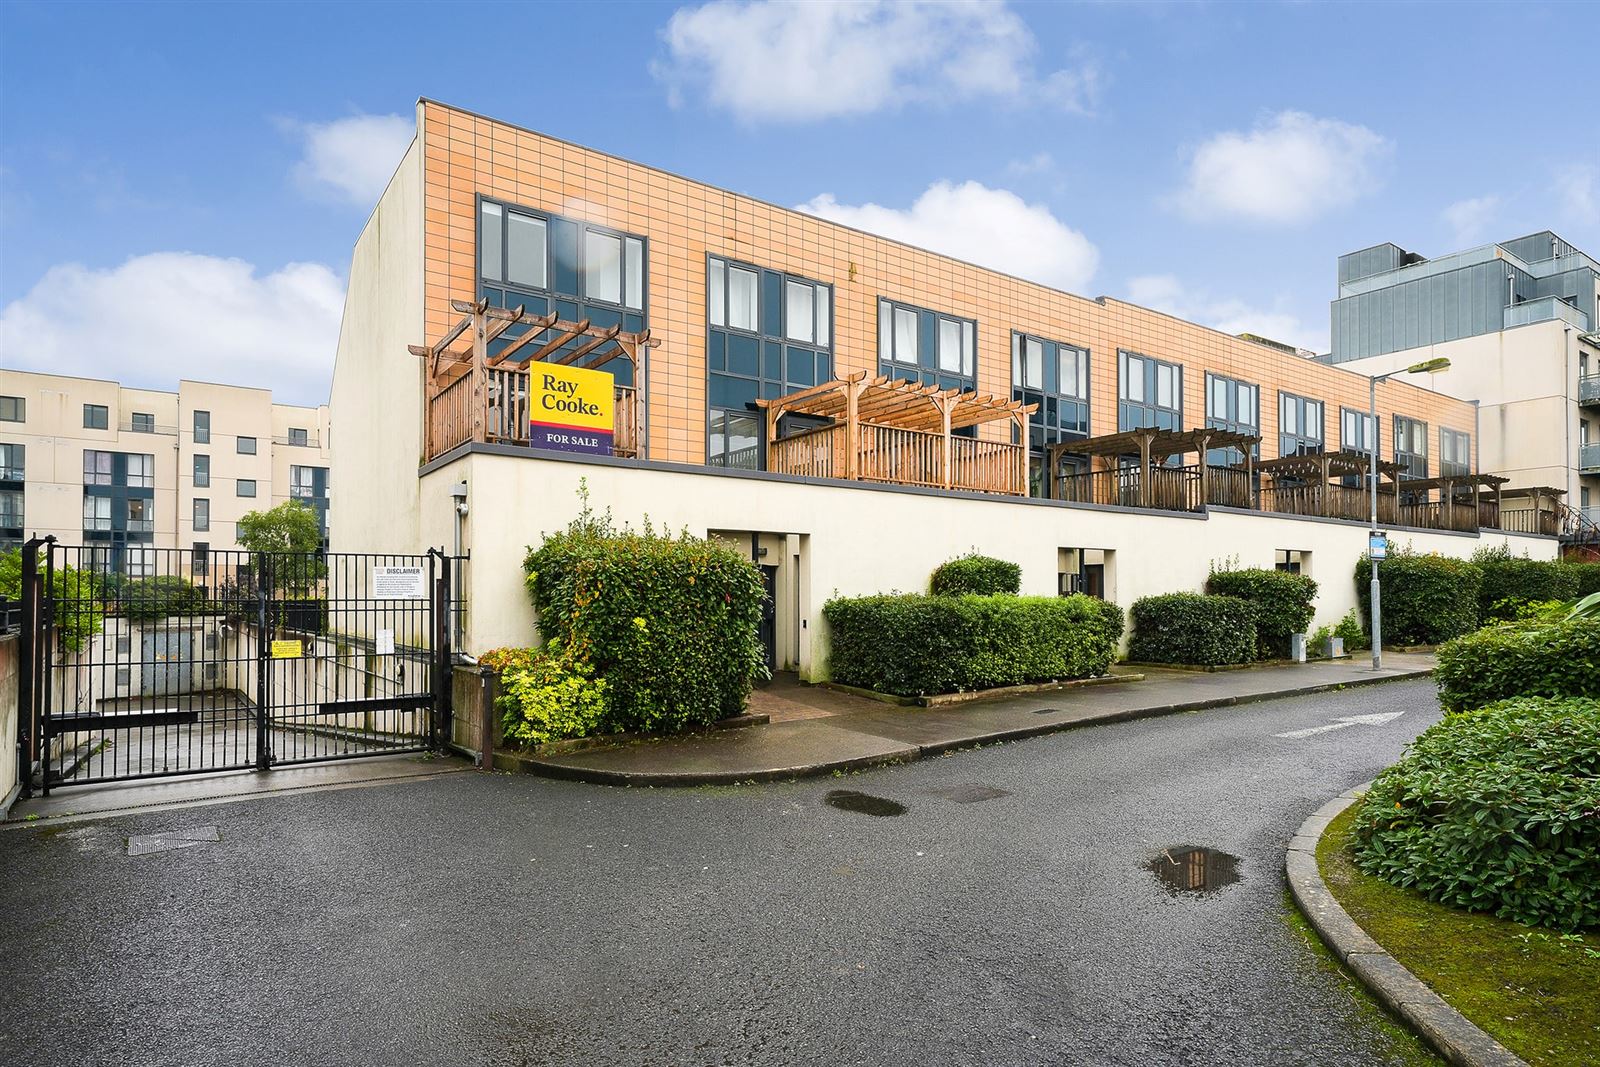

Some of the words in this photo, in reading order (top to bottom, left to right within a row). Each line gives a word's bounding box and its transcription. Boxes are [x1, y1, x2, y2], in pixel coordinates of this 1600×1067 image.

[542, 374, 579, 398] Ray
[541, 394, 603, 417] Cooke.
[547, 433, 569, 444] FOR
[571, 436, 599, 447] SALE
